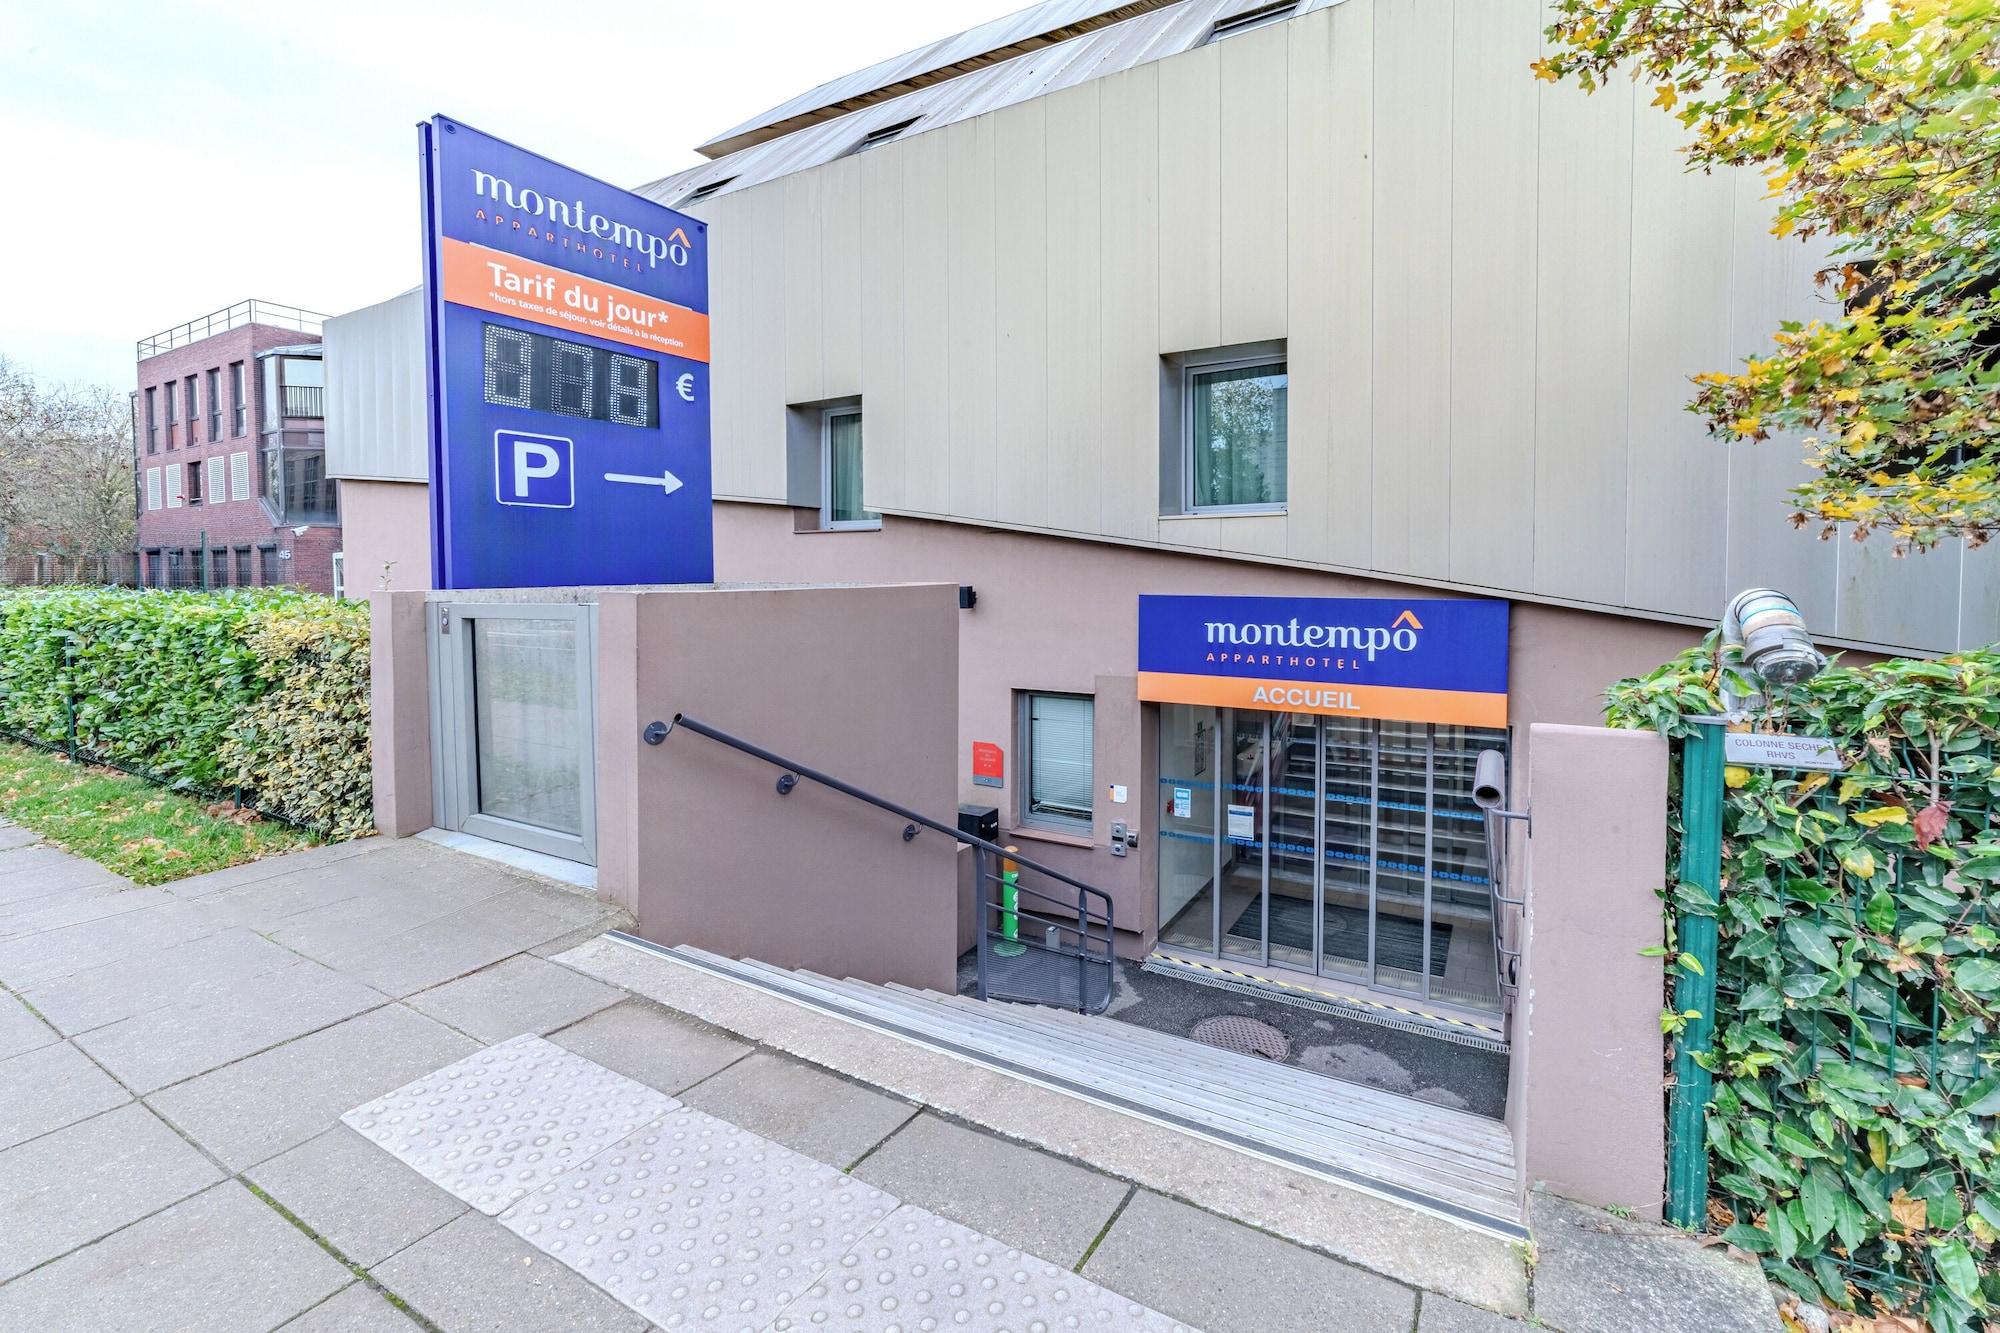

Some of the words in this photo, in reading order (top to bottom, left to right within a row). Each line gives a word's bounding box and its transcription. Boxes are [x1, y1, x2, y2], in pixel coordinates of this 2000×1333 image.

[470, 168, 692, 268] montempô
[475, 209, 644, 272] APPARTHOTEL
[487, 261, 555, 300] Tarif
[564, 285, 599, 313] du
[518, 300, 545, 313] taxes
[545, 306, 558, 317] de
[559, 308, 588, 325] séjour,
[589, 317, 606, 328] voir
[607, 321, 634, 336] détails
[640, 330, 649, 339] la
[649, 332, 684, 348] réception
[675, 372, 695, 402] €
[513, 441, 560, 498] P
[279, 550, 291, 560] 45
[1204, 609, 1424, 662] montempô
[1205, 652, 1360, 669] APPARTHOTEL
[1252, 686, 1361, 710] ACCUEIL
[1735, 738, 1785, 749] COLONNE
[1766, 751, 1796, 760] RHVS
